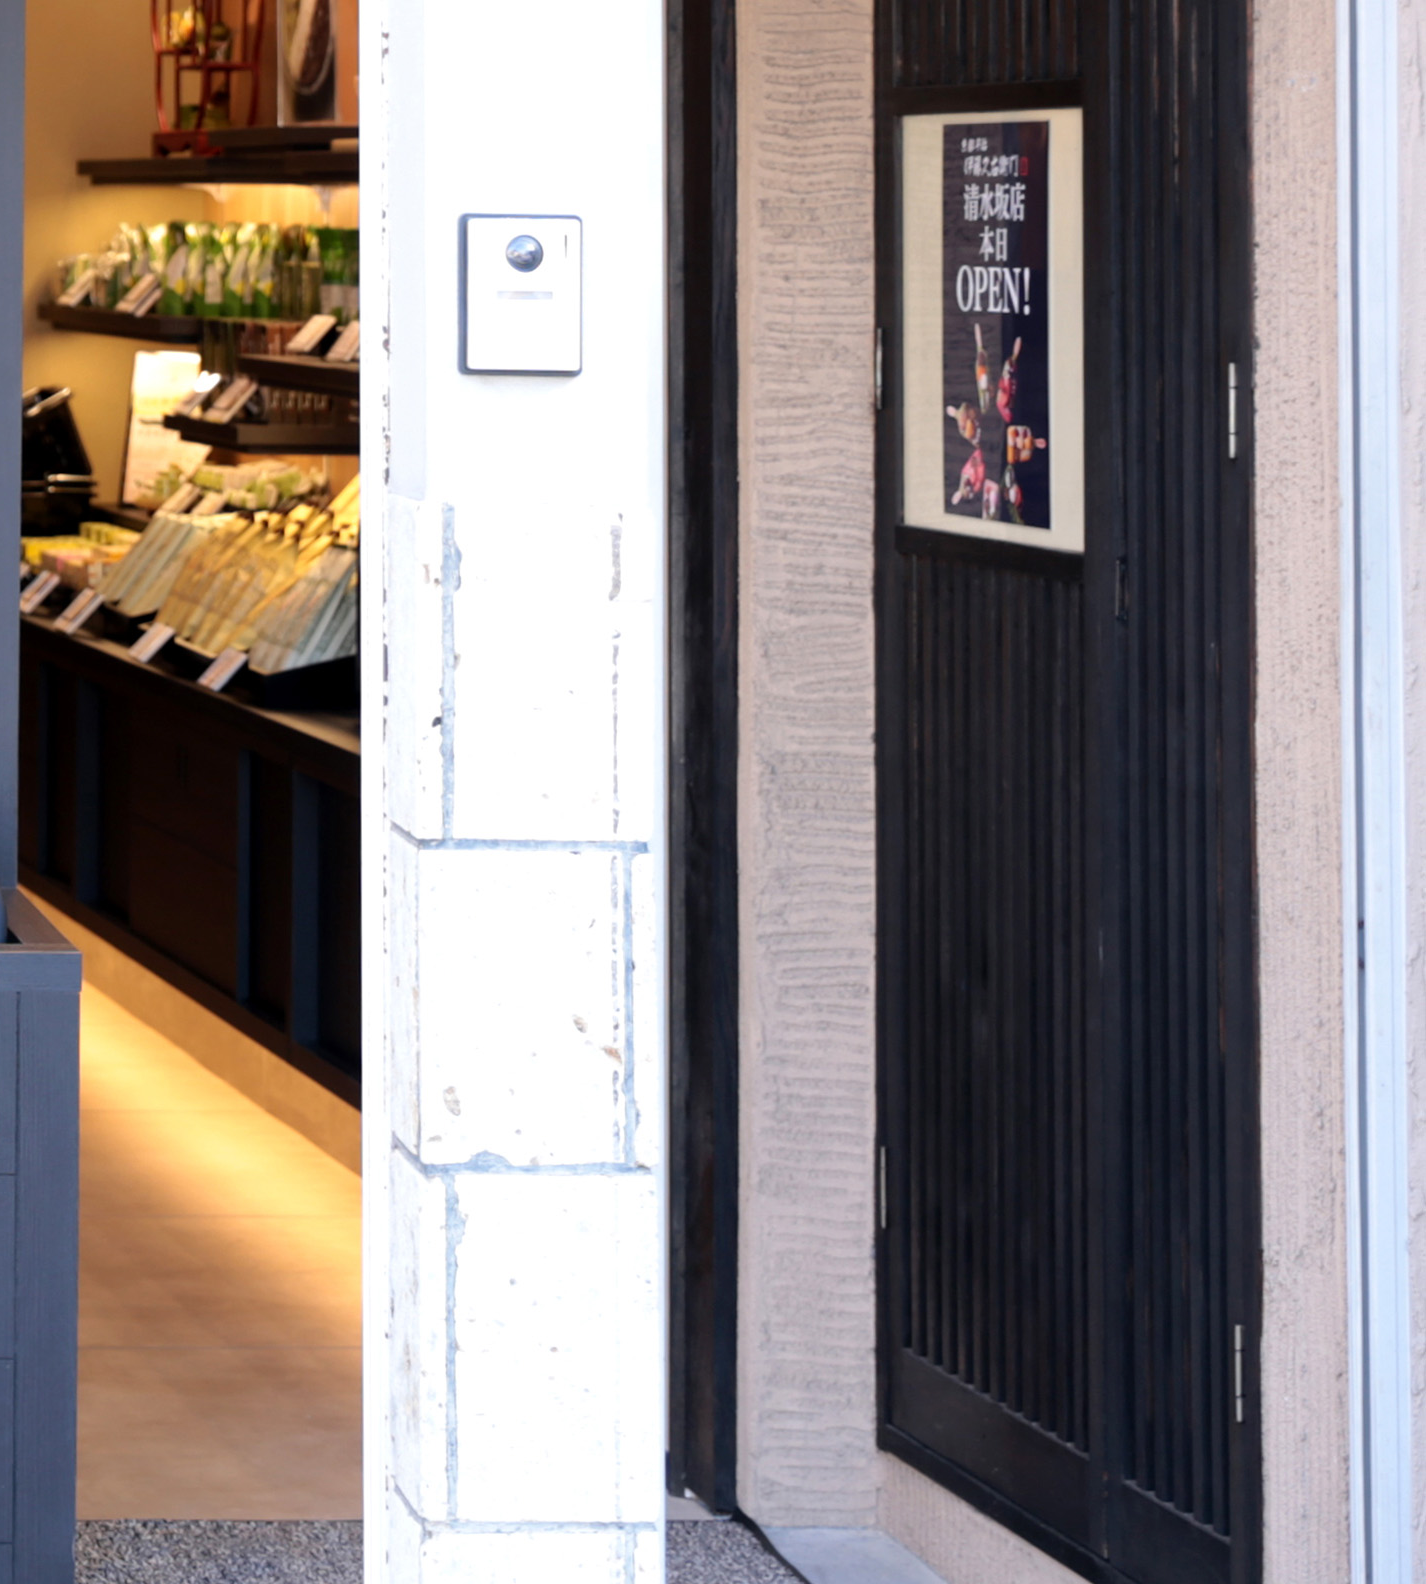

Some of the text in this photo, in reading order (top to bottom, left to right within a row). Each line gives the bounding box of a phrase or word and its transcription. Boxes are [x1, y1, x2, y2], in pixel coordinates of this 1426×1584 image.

[964, 183, 1025, 220] 清水坂店
[980, 226, 1007, 261] 本日
[956, 265, 1029, 314] OPEN!
